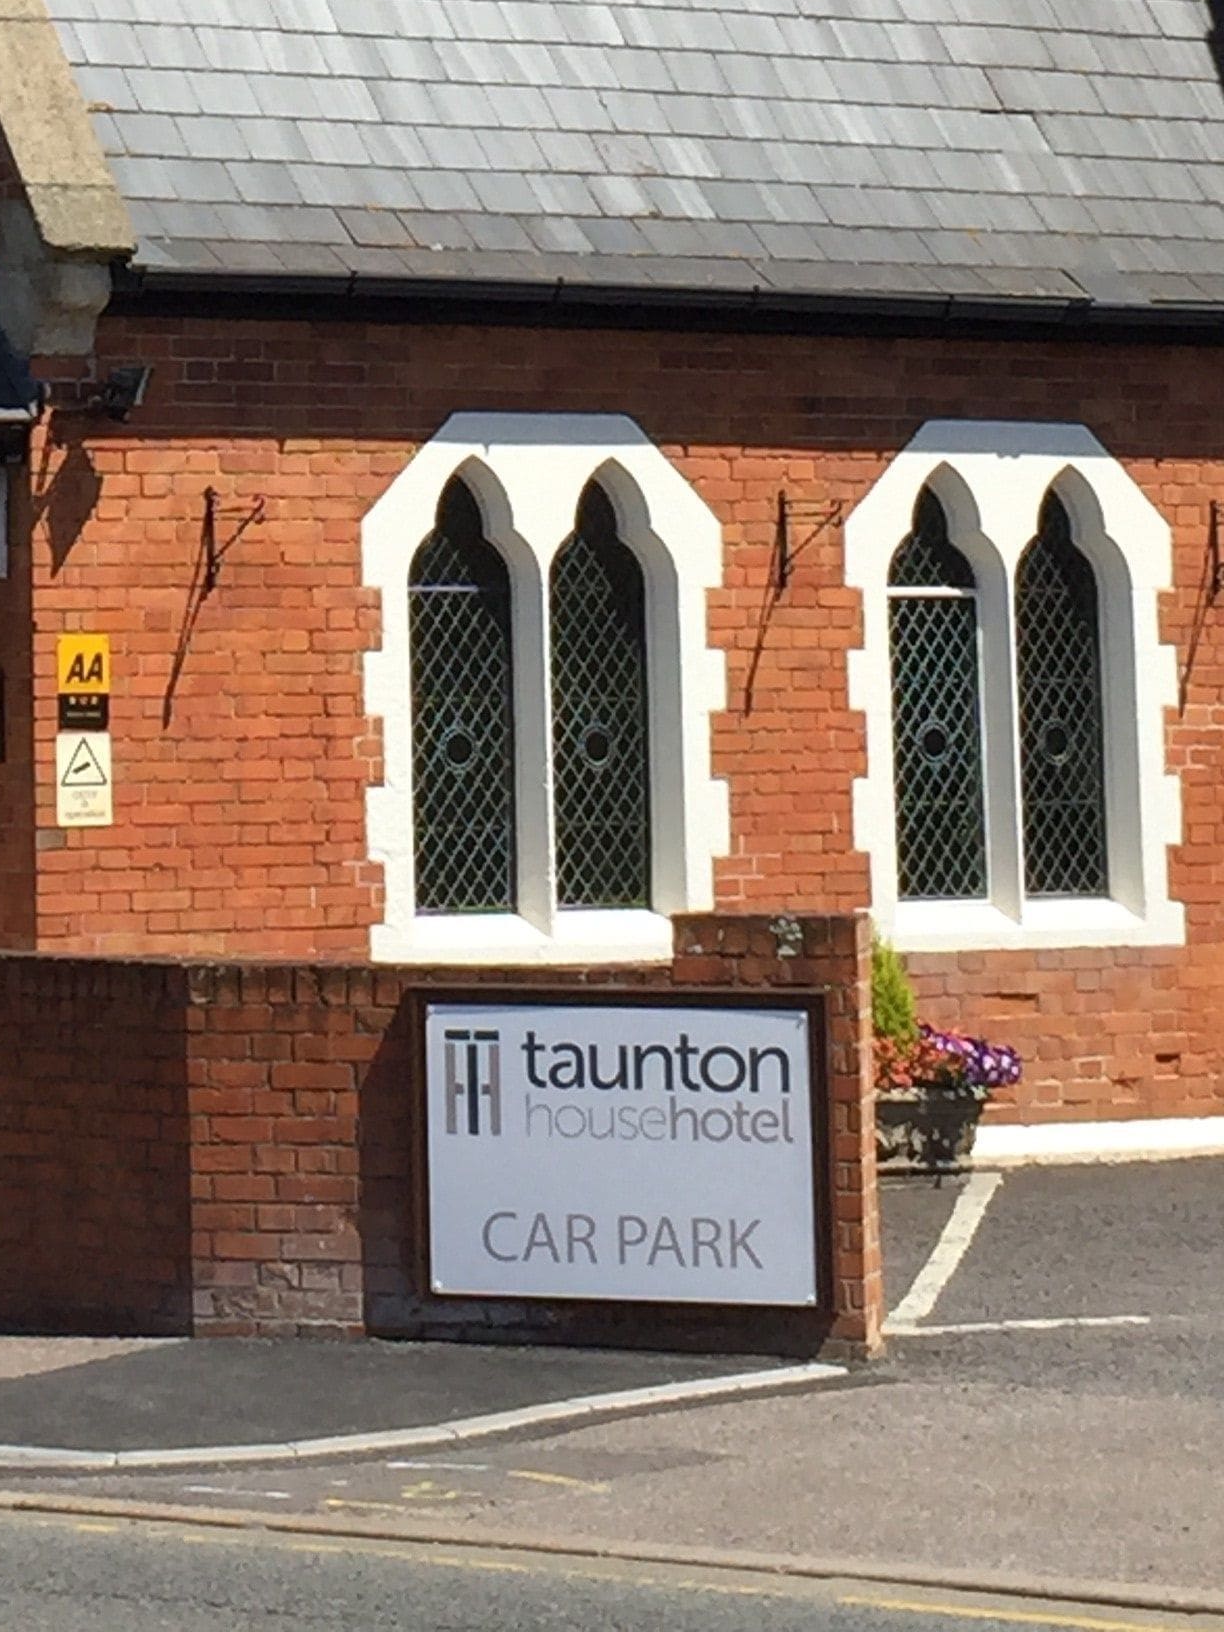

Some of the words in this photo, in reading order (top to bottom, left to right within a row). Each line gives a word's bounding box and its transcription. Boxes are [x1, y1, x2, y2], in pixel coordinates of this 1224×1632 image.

[66, 652, 104, 683] AA
[521, 1031, 790, 1093] taunton
[526, 1094, 794, 1144] househotel
[482, 1211, 597, 1264] CAR
[618, 1215, 764, 1270] PARK
